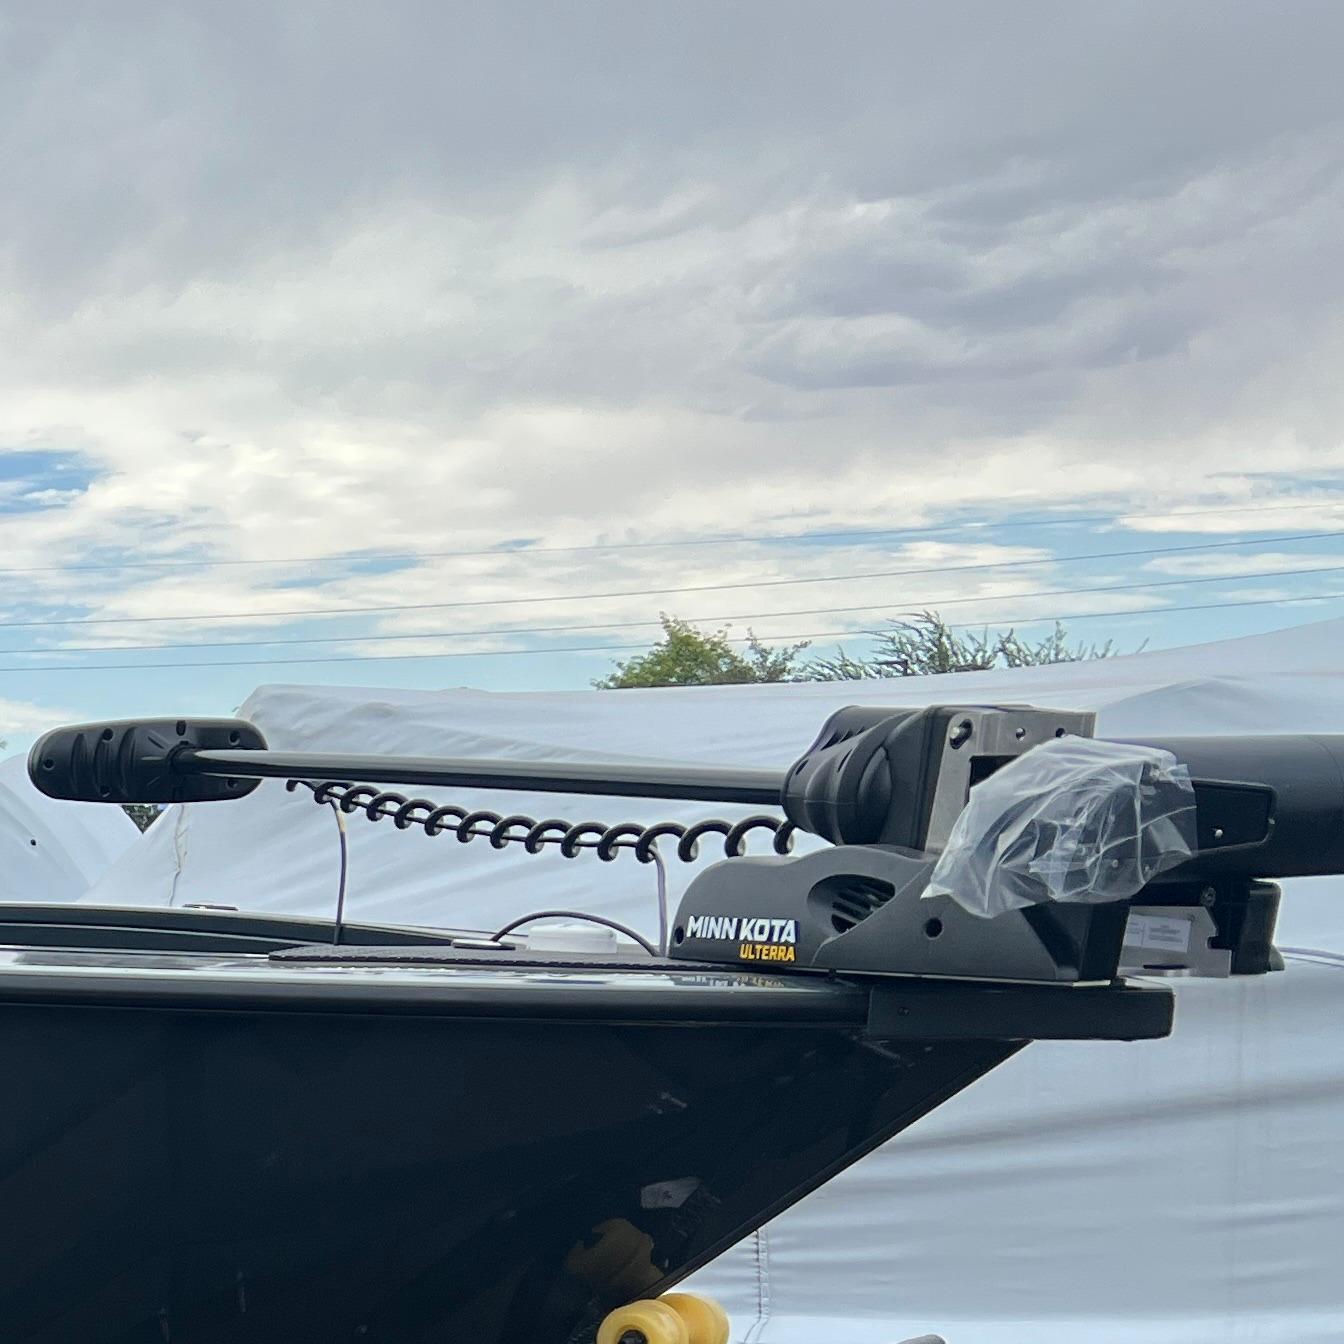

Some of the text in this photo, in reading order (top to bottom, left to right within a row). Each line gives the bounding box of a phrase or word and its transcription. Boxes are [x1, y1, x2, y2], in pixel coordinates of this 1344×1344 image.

[686, 915, 797, 944] MINN KOTA
[739, 943, 796, 962] ULTERRA
